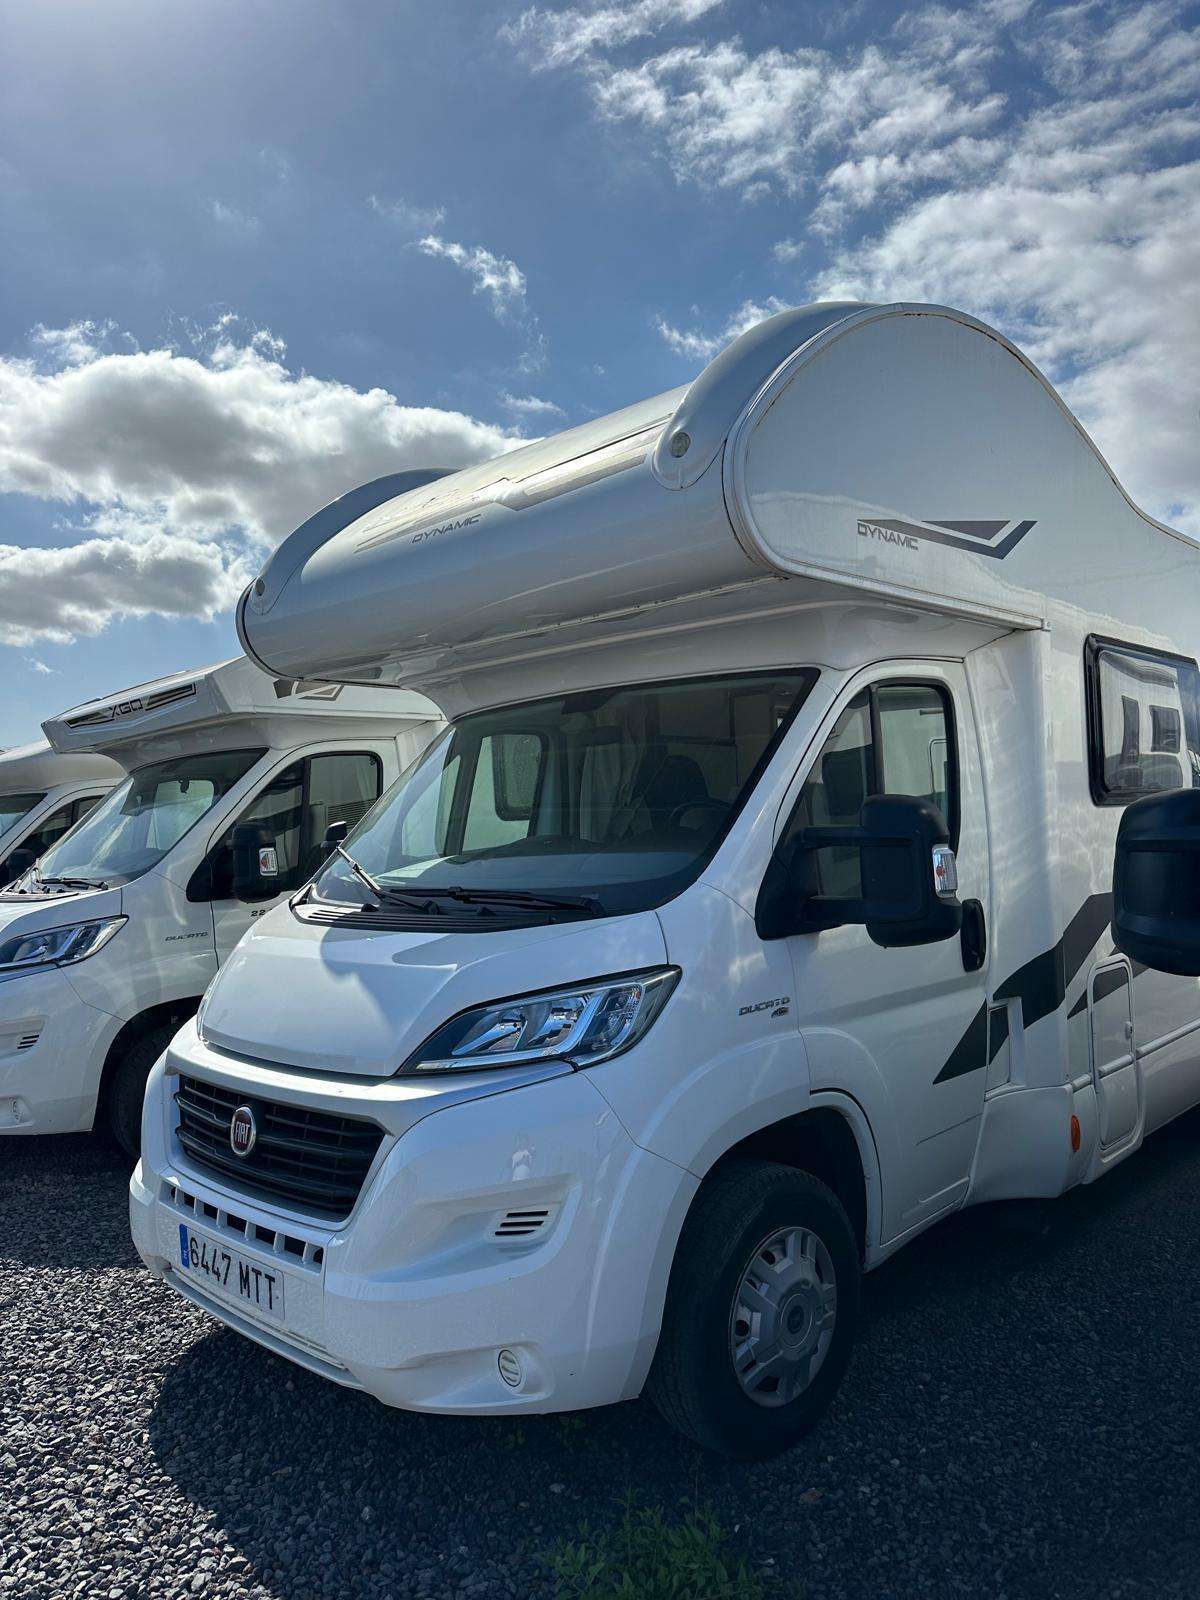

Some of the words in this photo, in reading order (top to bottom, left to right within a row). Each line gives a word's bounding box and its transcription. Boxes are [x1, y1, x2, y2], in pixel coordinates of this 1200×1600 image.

[411, 514, 481, 543] DYNAMIC
[857, 522, 918, 550] DYNAMIC
[109, 699, 142, 717] XGO
[165, 932, 208, 941] DUCATO
[739, 996, 790, 1015] DUCATO
[235, 1121, 250, 1144] FIAT
[190, 1237, 231, 1285] 6447
[239, 1261, 275, 1310] MTT
